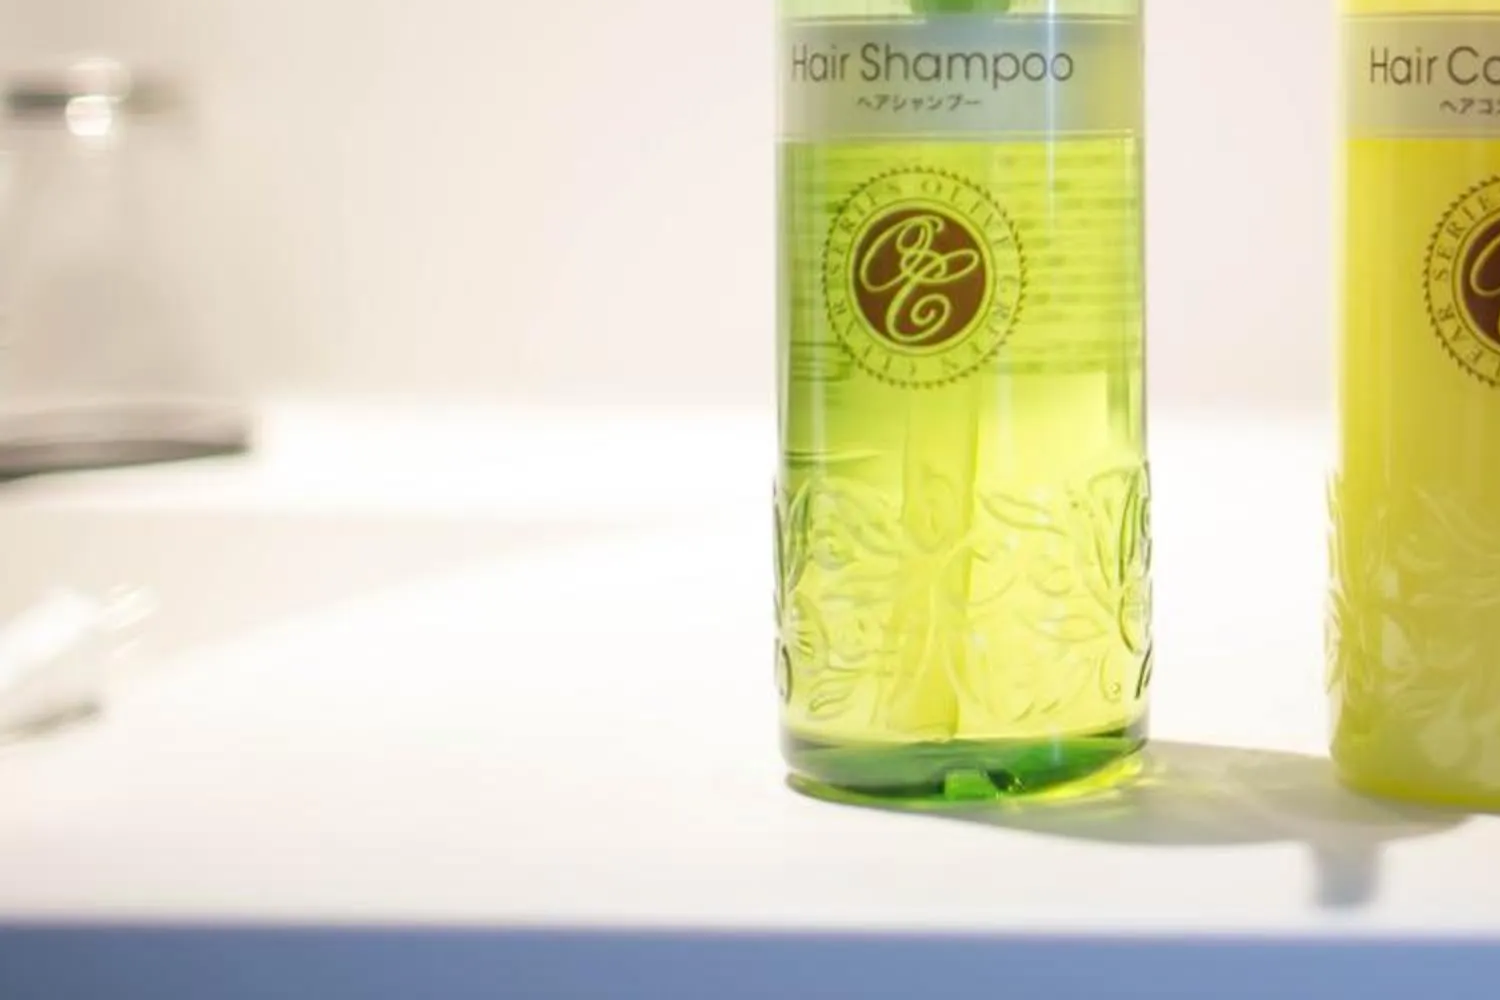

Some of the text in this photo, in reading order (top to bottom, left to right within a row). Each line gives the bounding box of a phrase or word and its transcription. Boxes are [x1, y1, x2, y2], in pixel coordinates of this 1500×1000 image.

[791, 42, 1074, 90] Hair Shampoo
[1369, 46, 1438, 85] Hair
